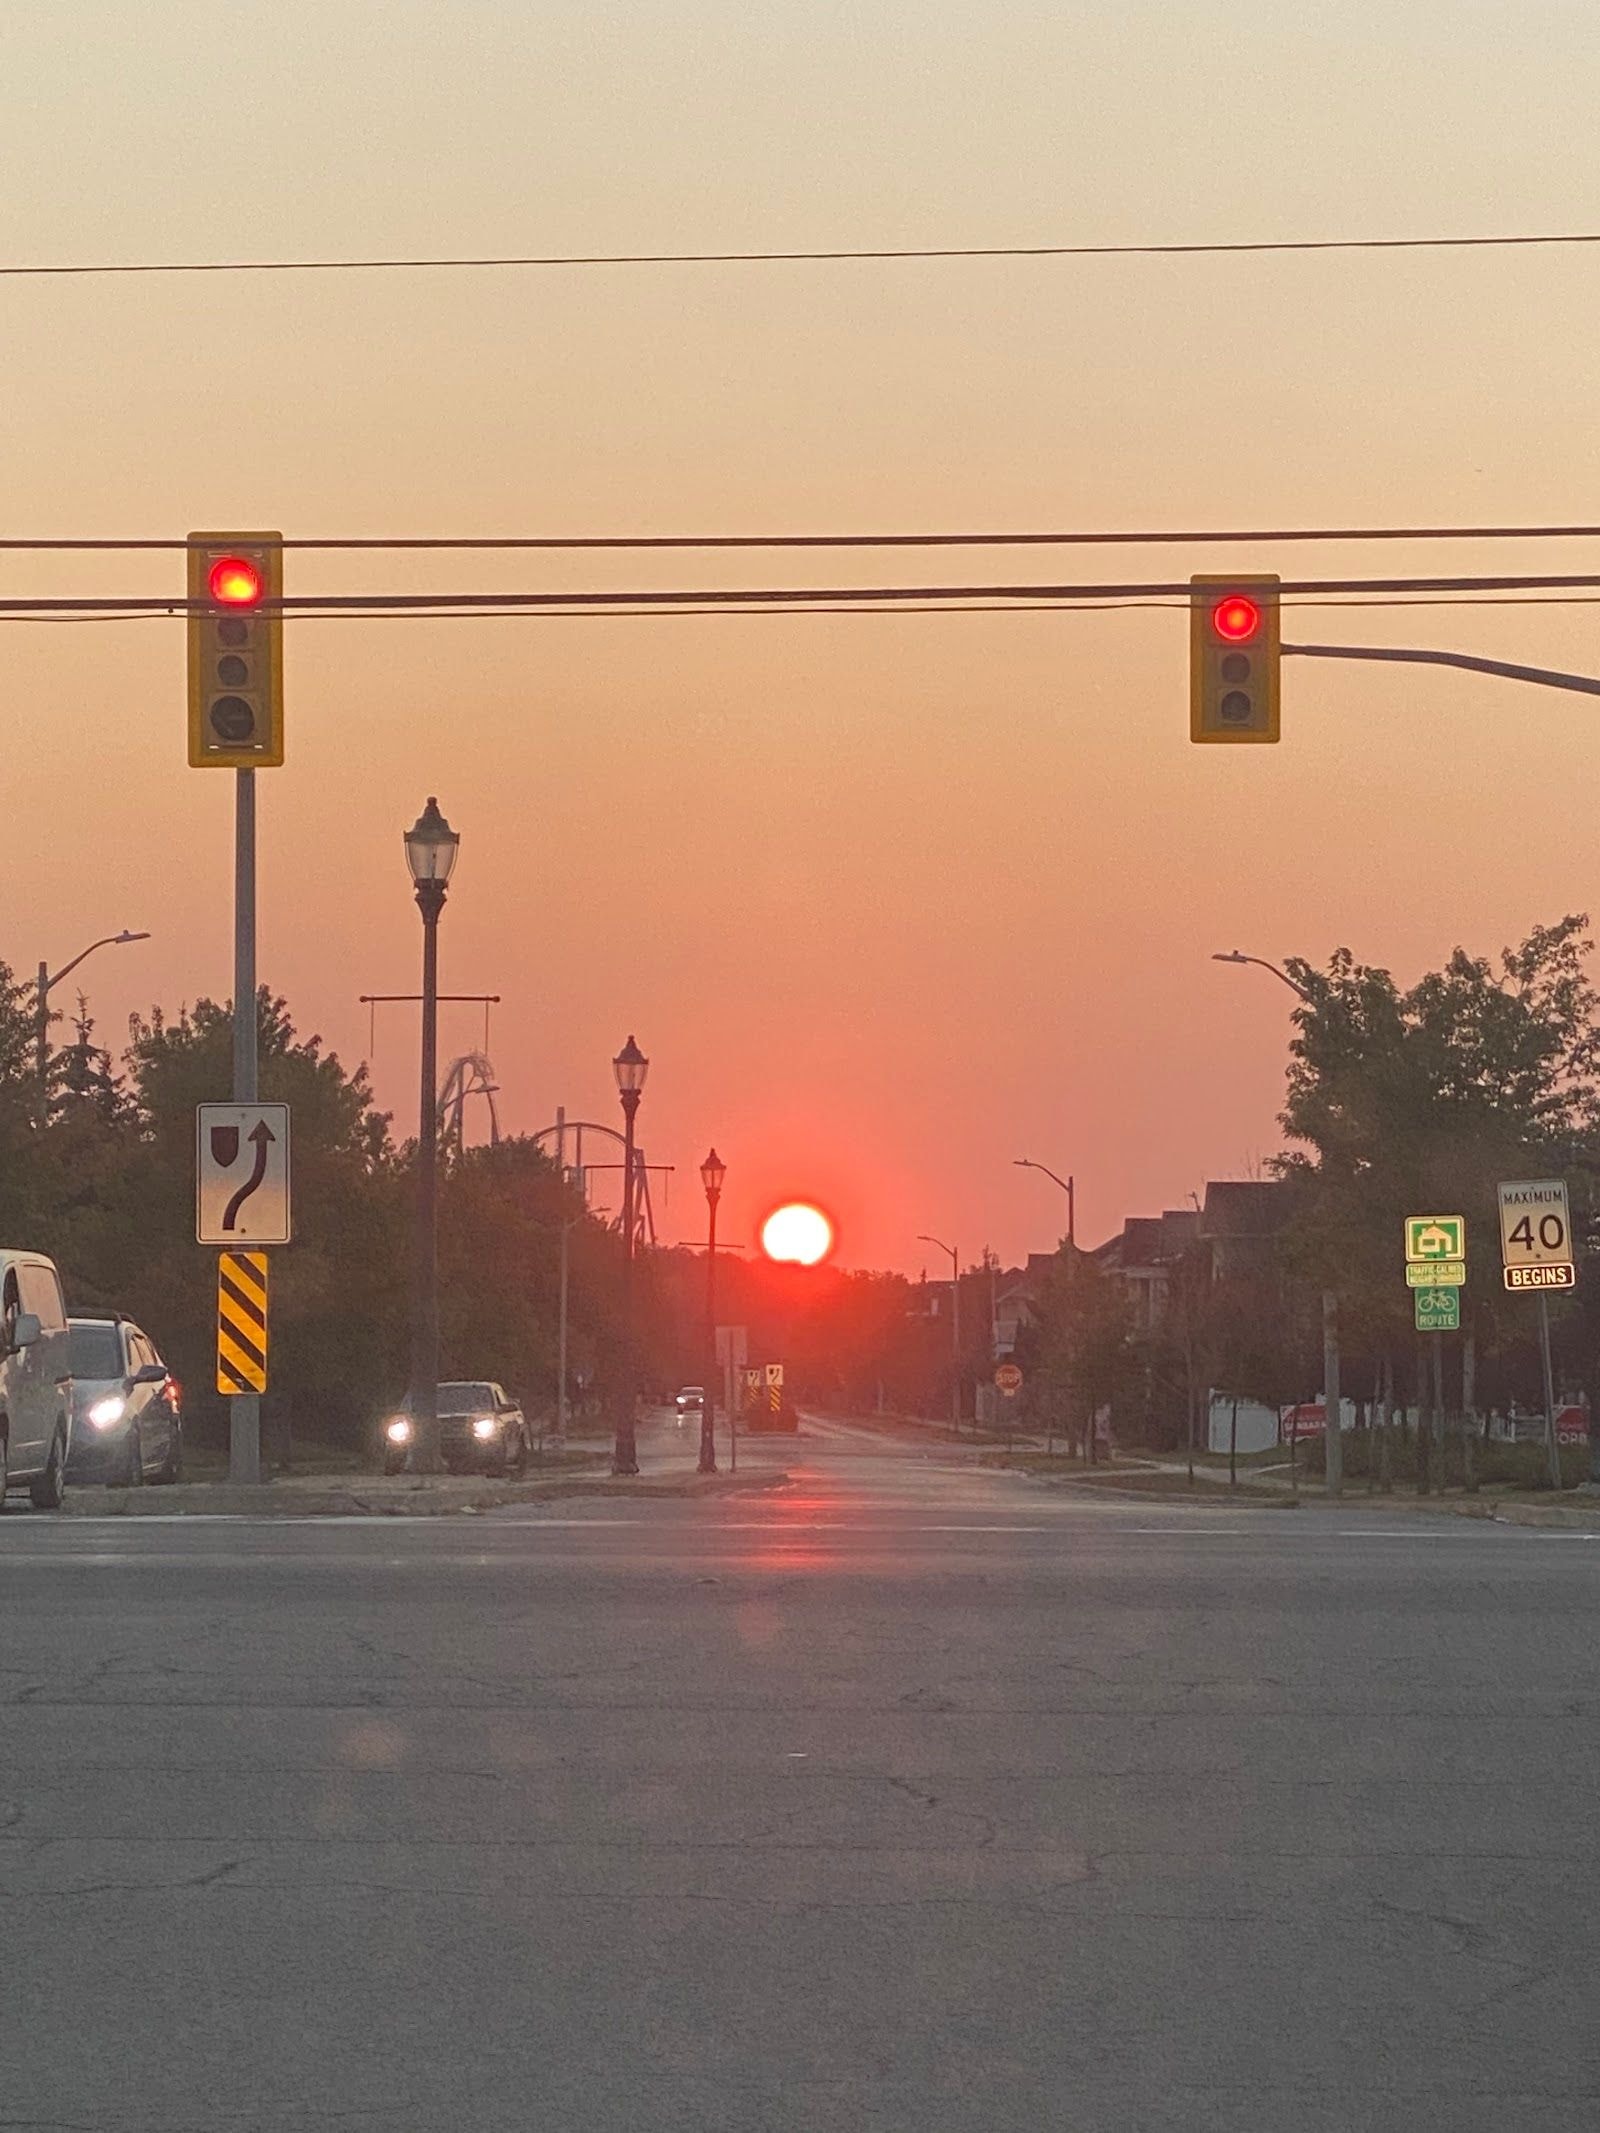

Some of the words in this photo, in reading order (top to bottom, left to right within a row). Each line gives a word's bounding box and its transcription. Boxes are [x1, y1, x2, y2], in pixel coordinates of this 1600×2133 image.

[1504, 1190, 1563, 1204] MAXIMUM
[1508, 1214, 1564, 1250] 40
[1511, 1267, 1567, 1286] BEGINS
[1419, 1313, 1455, 1326] ROUTE
[997, 1373, 1019, 1384] STOP
